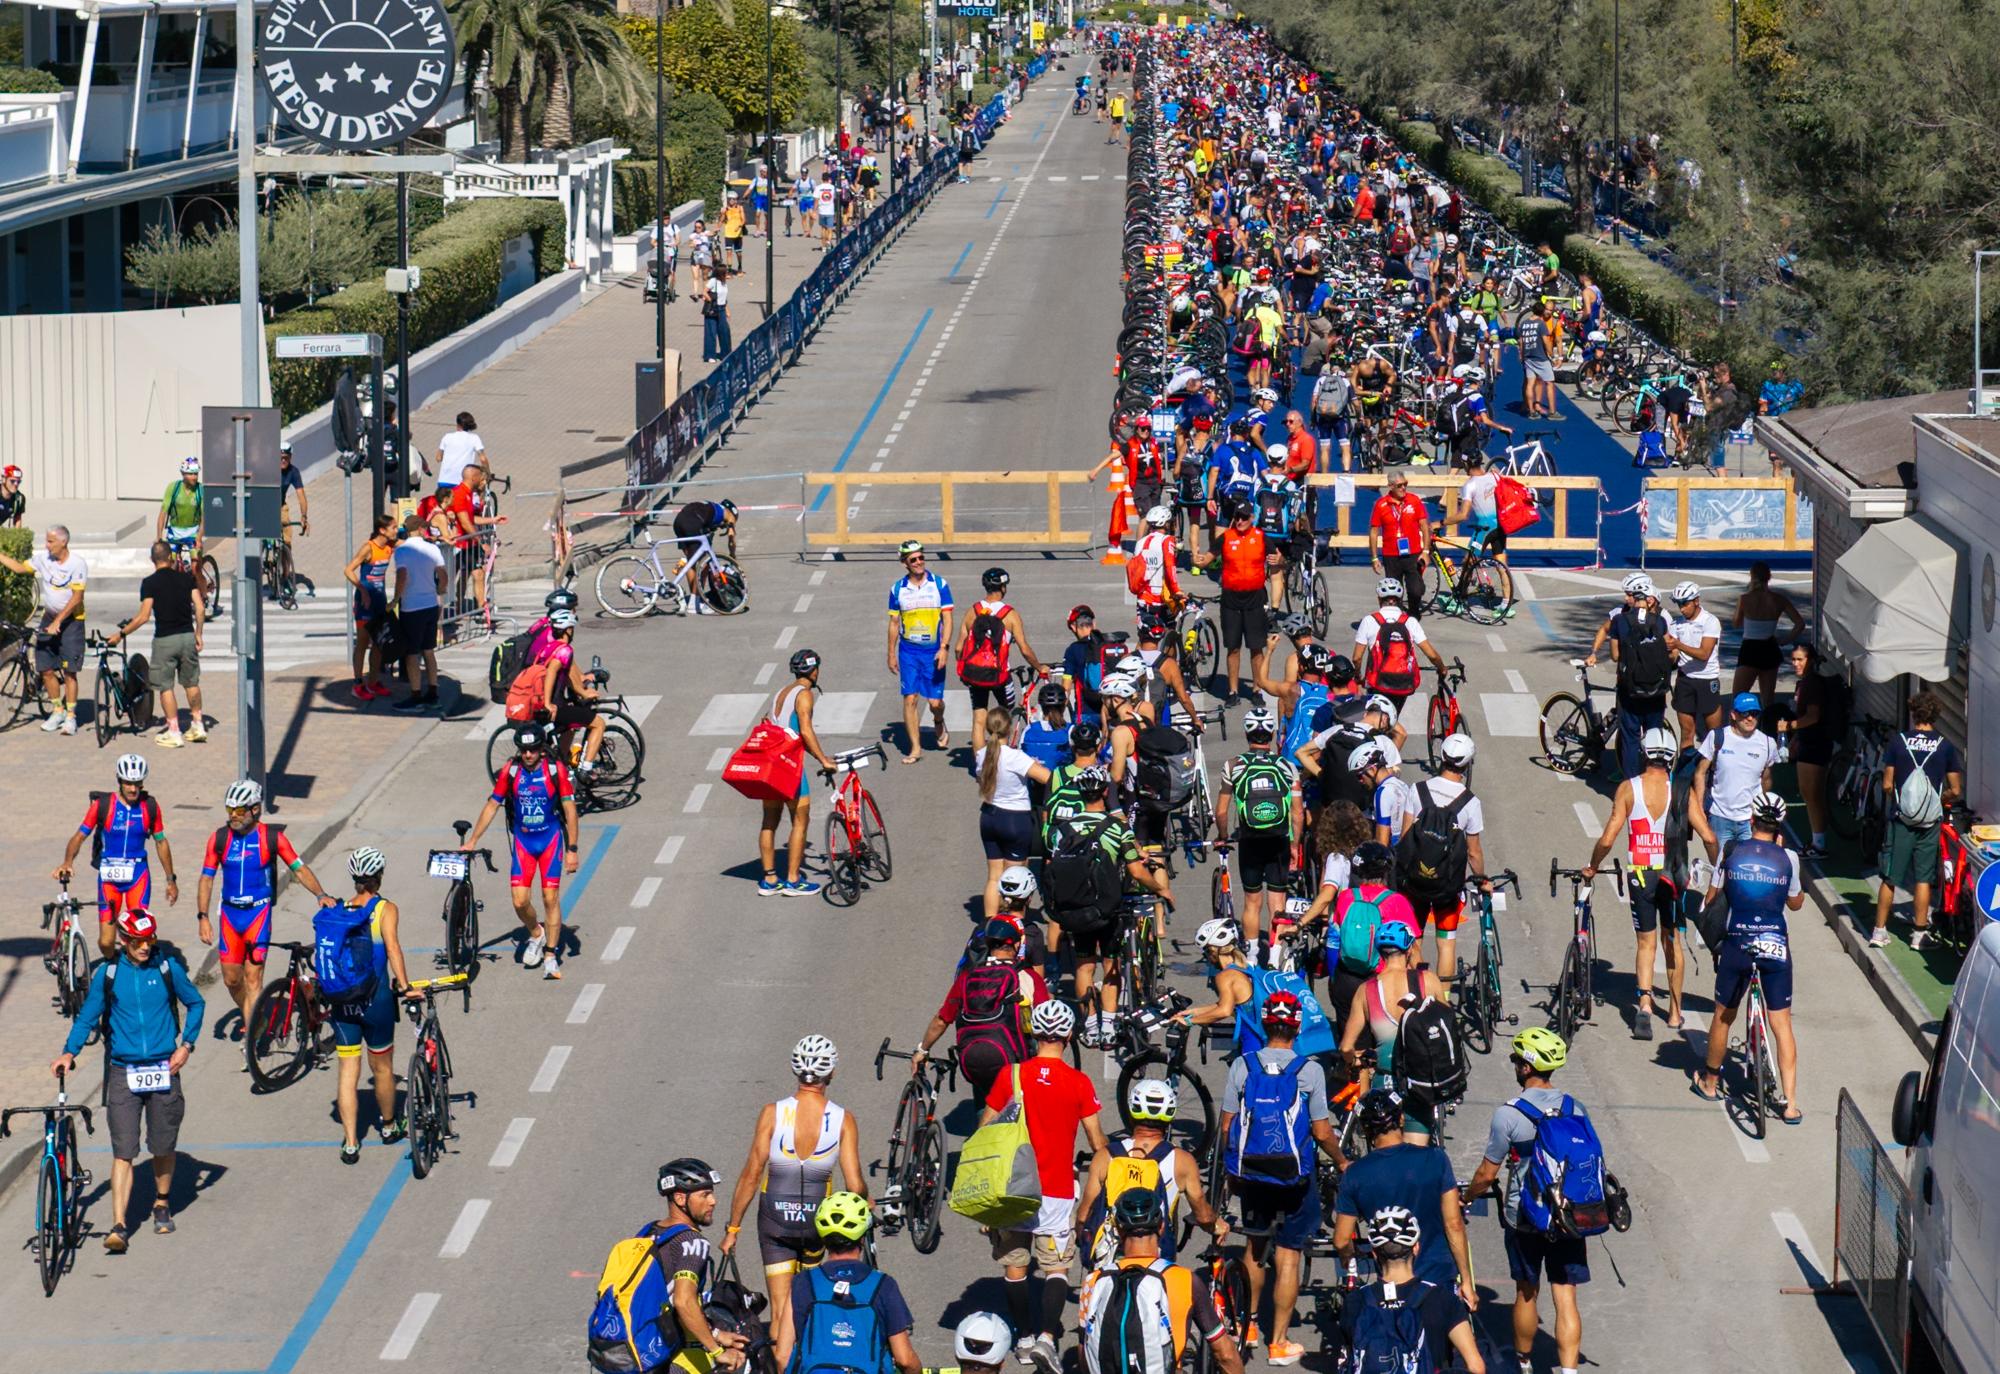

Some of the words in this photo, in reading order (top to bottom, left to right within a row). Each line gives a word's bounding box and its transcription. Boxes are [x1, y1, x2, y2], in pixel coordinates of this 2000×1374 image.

[958, 7, 996, 16] HOTEL
[264, 58, 446, 142] RESIDENCE
[303, 343, 342, 353] Ferrara
[1907, 737, 1937, 747] ITALIA
[521, 805, 545, 816] ITA
[107, 867, 126, 879] 681
[437, 863, 458, 876] 755
[1727, 870, 1755, 881] Ottica
[1756, 872, 1788, 886] Biondi
[1293, 901, 1313, 914] 37
[343, 1005, 365, 1017] ITA
[136, 1072, 163, 1088] 909
[774, 1201, 817, 1212] MENGOLI
[783, 1210, 806, 1222] ITA
[681, 1238, 711, 1259] MT
